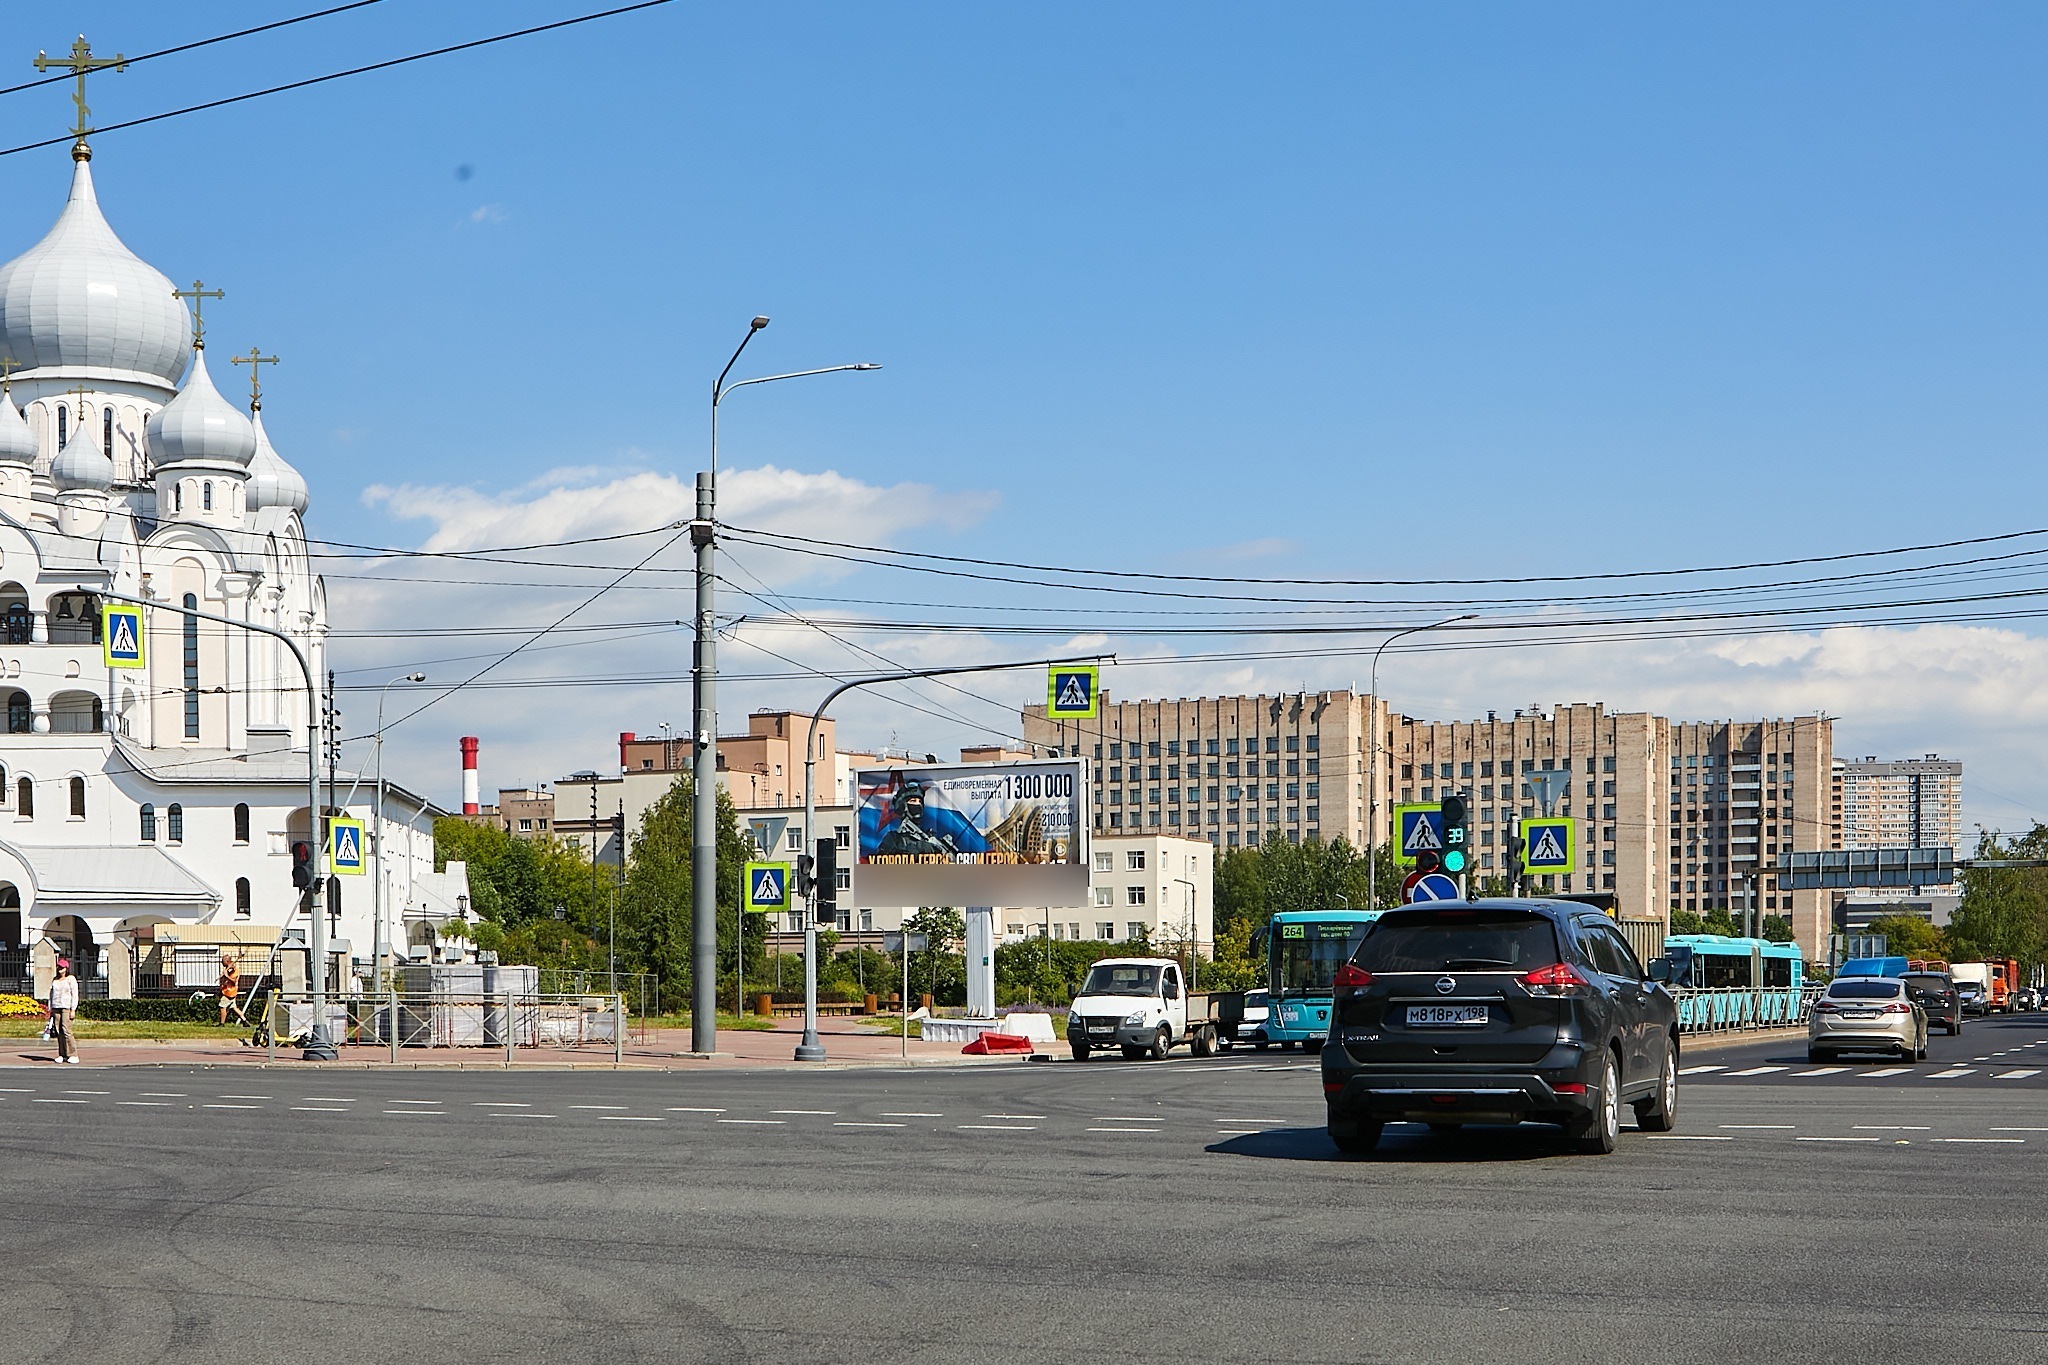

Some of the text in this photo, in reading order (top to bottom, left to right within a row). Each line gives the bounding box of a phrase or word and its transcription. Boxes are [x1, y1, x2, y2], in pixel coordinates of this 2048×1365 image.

[943, 780, 1002, 791] ЕДИНОВРЕМЕННАЯ
[971, 791, 1002, 800] ВЫПЛАТА
[1448, 827, 1464, 844] 39
[1284, 927, 1302, 937] 264
